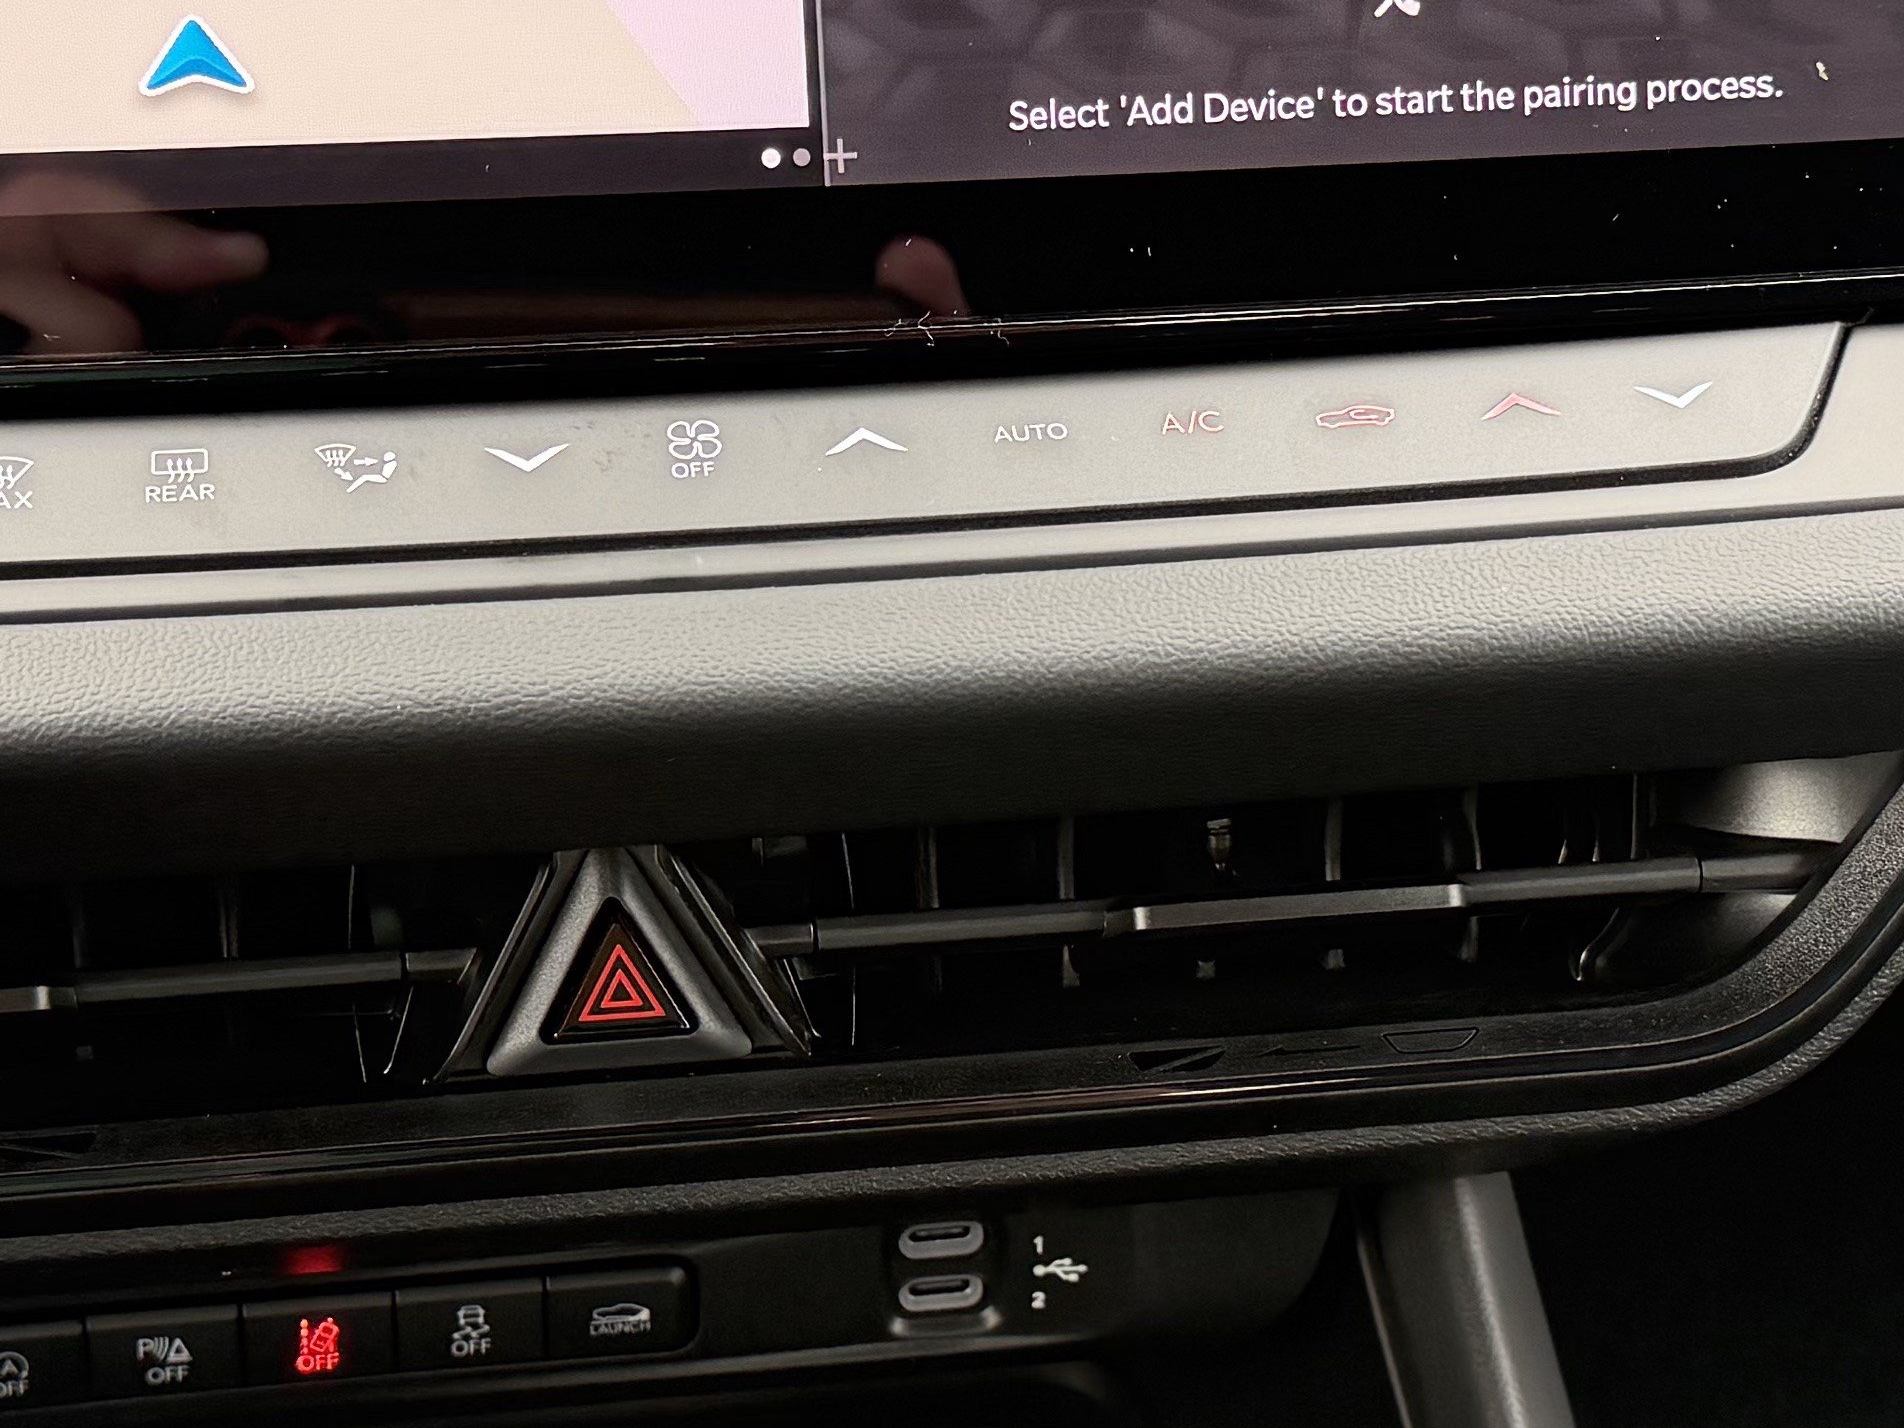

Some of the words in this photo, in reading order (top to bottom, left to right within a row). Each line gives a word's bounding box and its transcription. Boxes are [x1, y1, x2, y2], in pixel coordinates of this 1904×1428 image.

[1008, 98, 1110, 133] Select
[1120, 93, 1194, 127] 'Add
[1203, 90, 1324, 126] Device'
[1332, 90, 1368, 118] to
[1376, 83, 1454, 116] start
[1460, 80, 1514, 112] the
[1523, 72, 1637, 113] pairing
[1646, 71, 1785, 114] process.
[994, 422, 1068, 444] AUTO
[1162, 410, 1224, 436] A/C
[671, 460, 715, 478] OFF
[145, 482, 216, 504] REAR
[1033, 1235, 1044, 1255] 1
[1031, 1291, 1046, 1309] 2
[590, 1320, 651, 1337] LAUNCH
[451, 1338, 491, 1358] OFF
[296, 1353, 340, 1373] OFF
[145, 1365, 190, 1386] OFF
